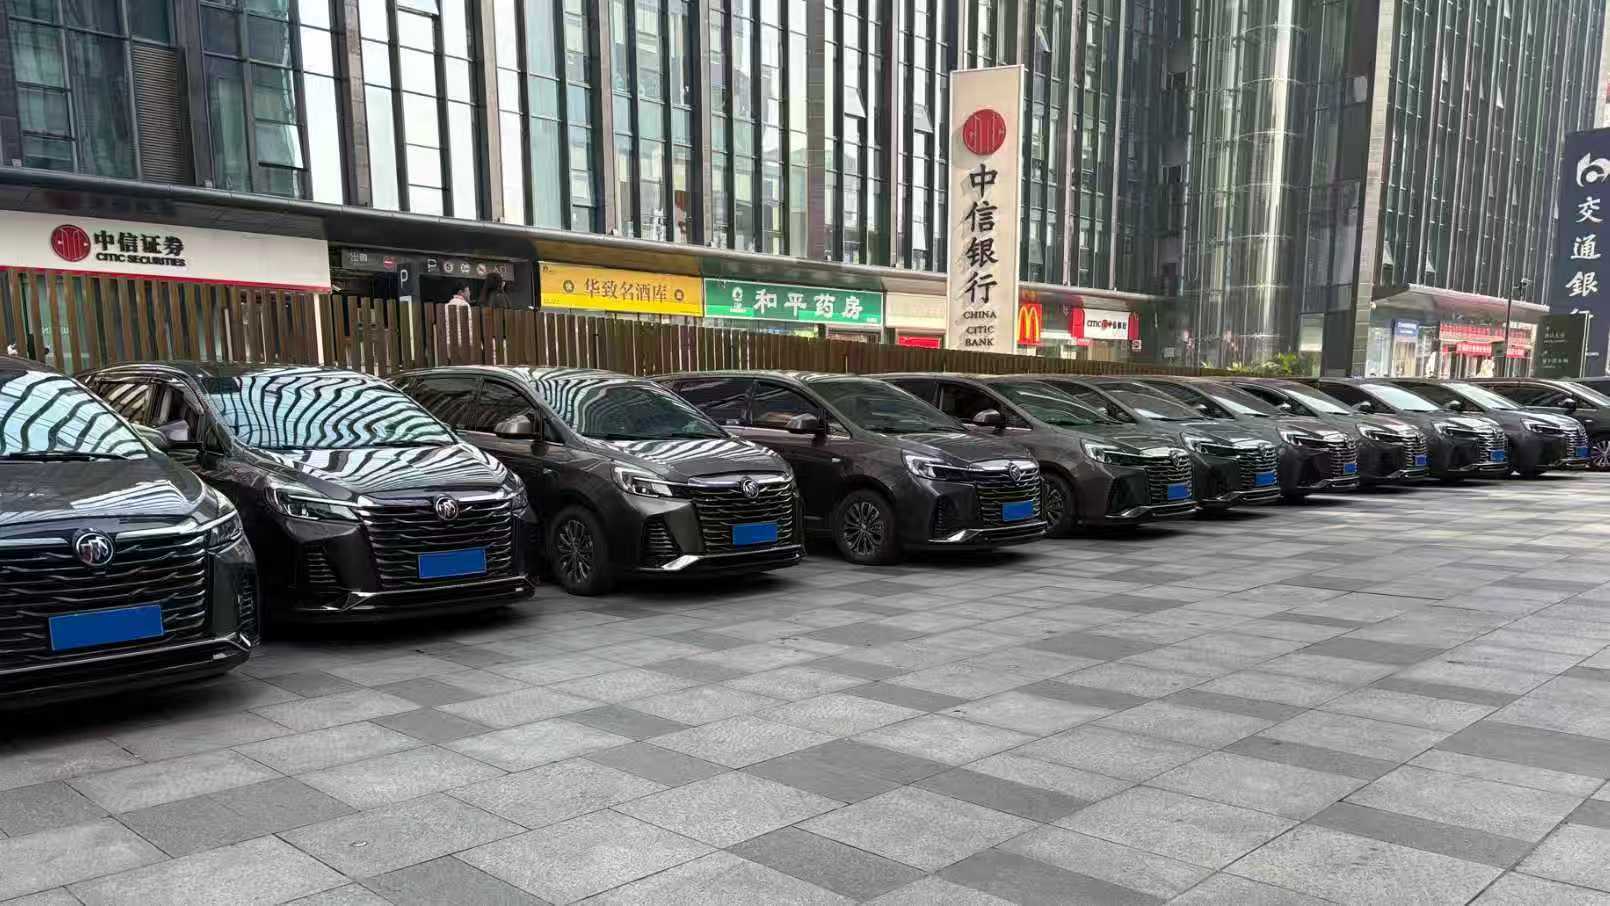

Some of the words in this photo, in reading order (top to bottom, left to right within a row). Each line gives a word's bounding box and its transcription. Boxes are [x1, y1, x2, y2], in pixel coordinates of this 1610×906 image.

[964, 163, 998, 304] 中信银行
[94, 230, 184, 257] 中信证券
[96, 252, 125, 263] CITIC
[127, 256, 186, 267] SECURITIES
[400, 269, 408, 288] P
[584, 277, 667, 302] 华致名酒库
[753, 288, 863, 319] 和平药房
[963, 310, 997, 319] CHINA
[966, 325, 994, 334] CITIC
[965, 338, 994, 346] BANK
